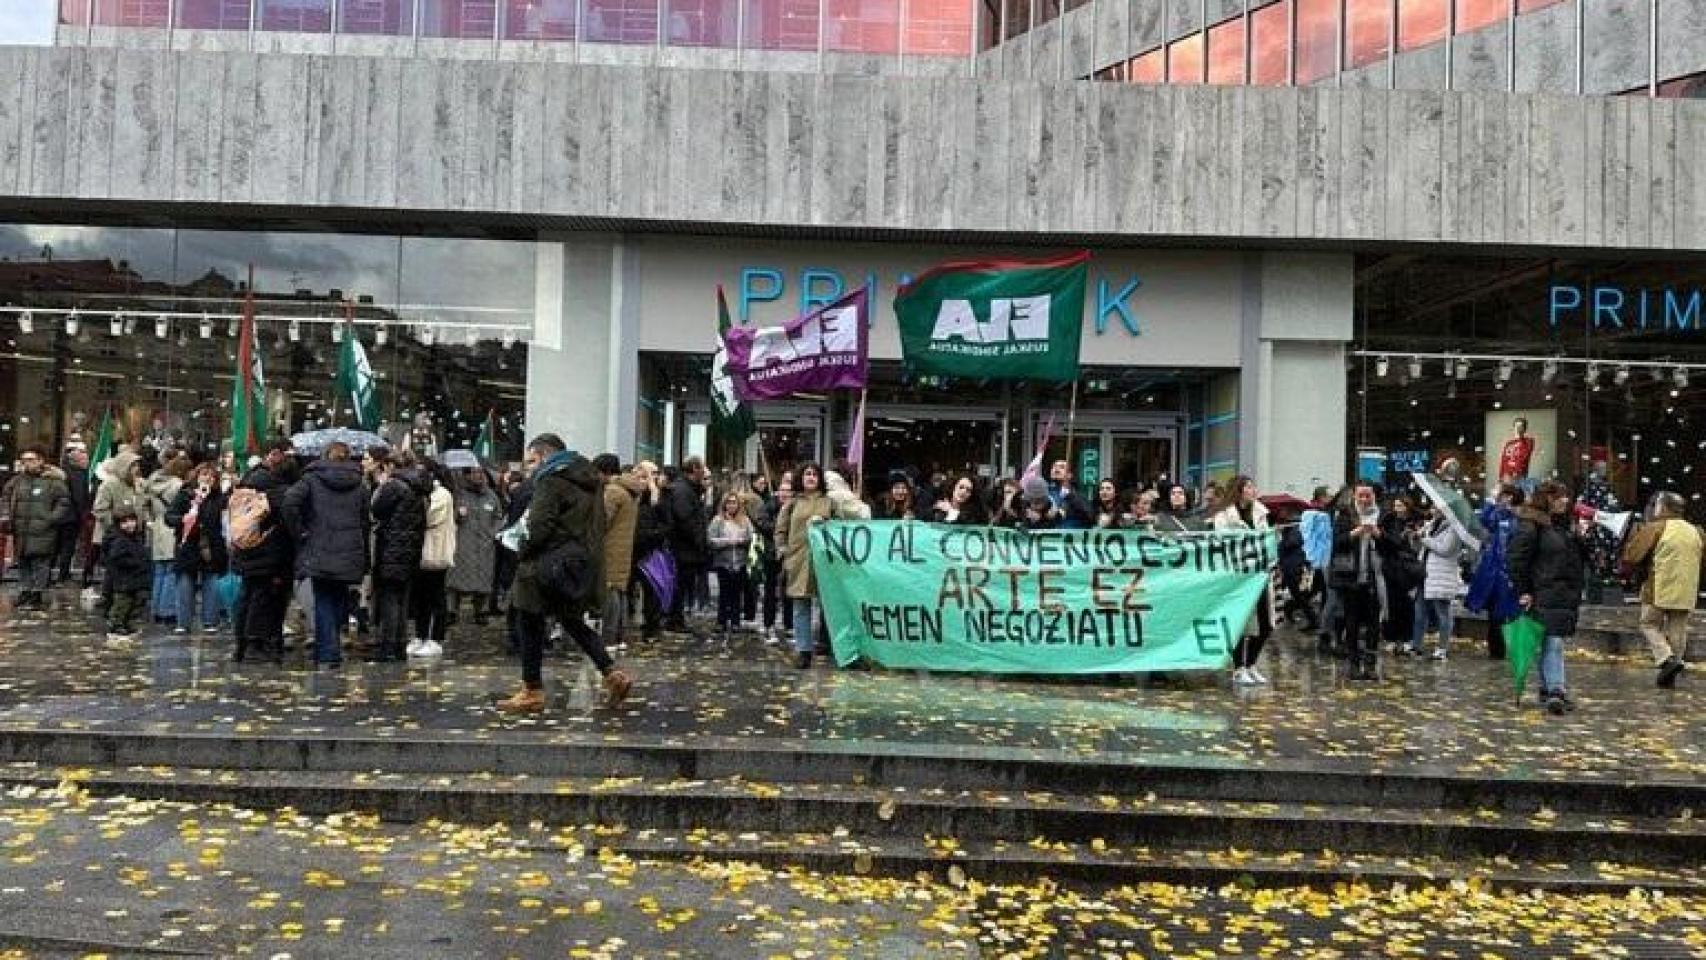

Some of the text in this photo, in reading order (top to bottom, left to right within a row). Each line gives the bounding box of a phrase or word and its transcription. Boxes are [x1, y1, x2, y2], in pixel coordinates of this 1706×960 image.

[741, 267, 1142, 337] PRIK
[1550, 285, 1701, 330] PRIM
[821, 525, 872, 564] NO
[887, 523, 927, 563] AL
[939, 529, 1127, 567] CONVENIO
[938, 567, 1153, 612] ARTE EZ
[964, 607, 1144, 648] NEGOZIATU
